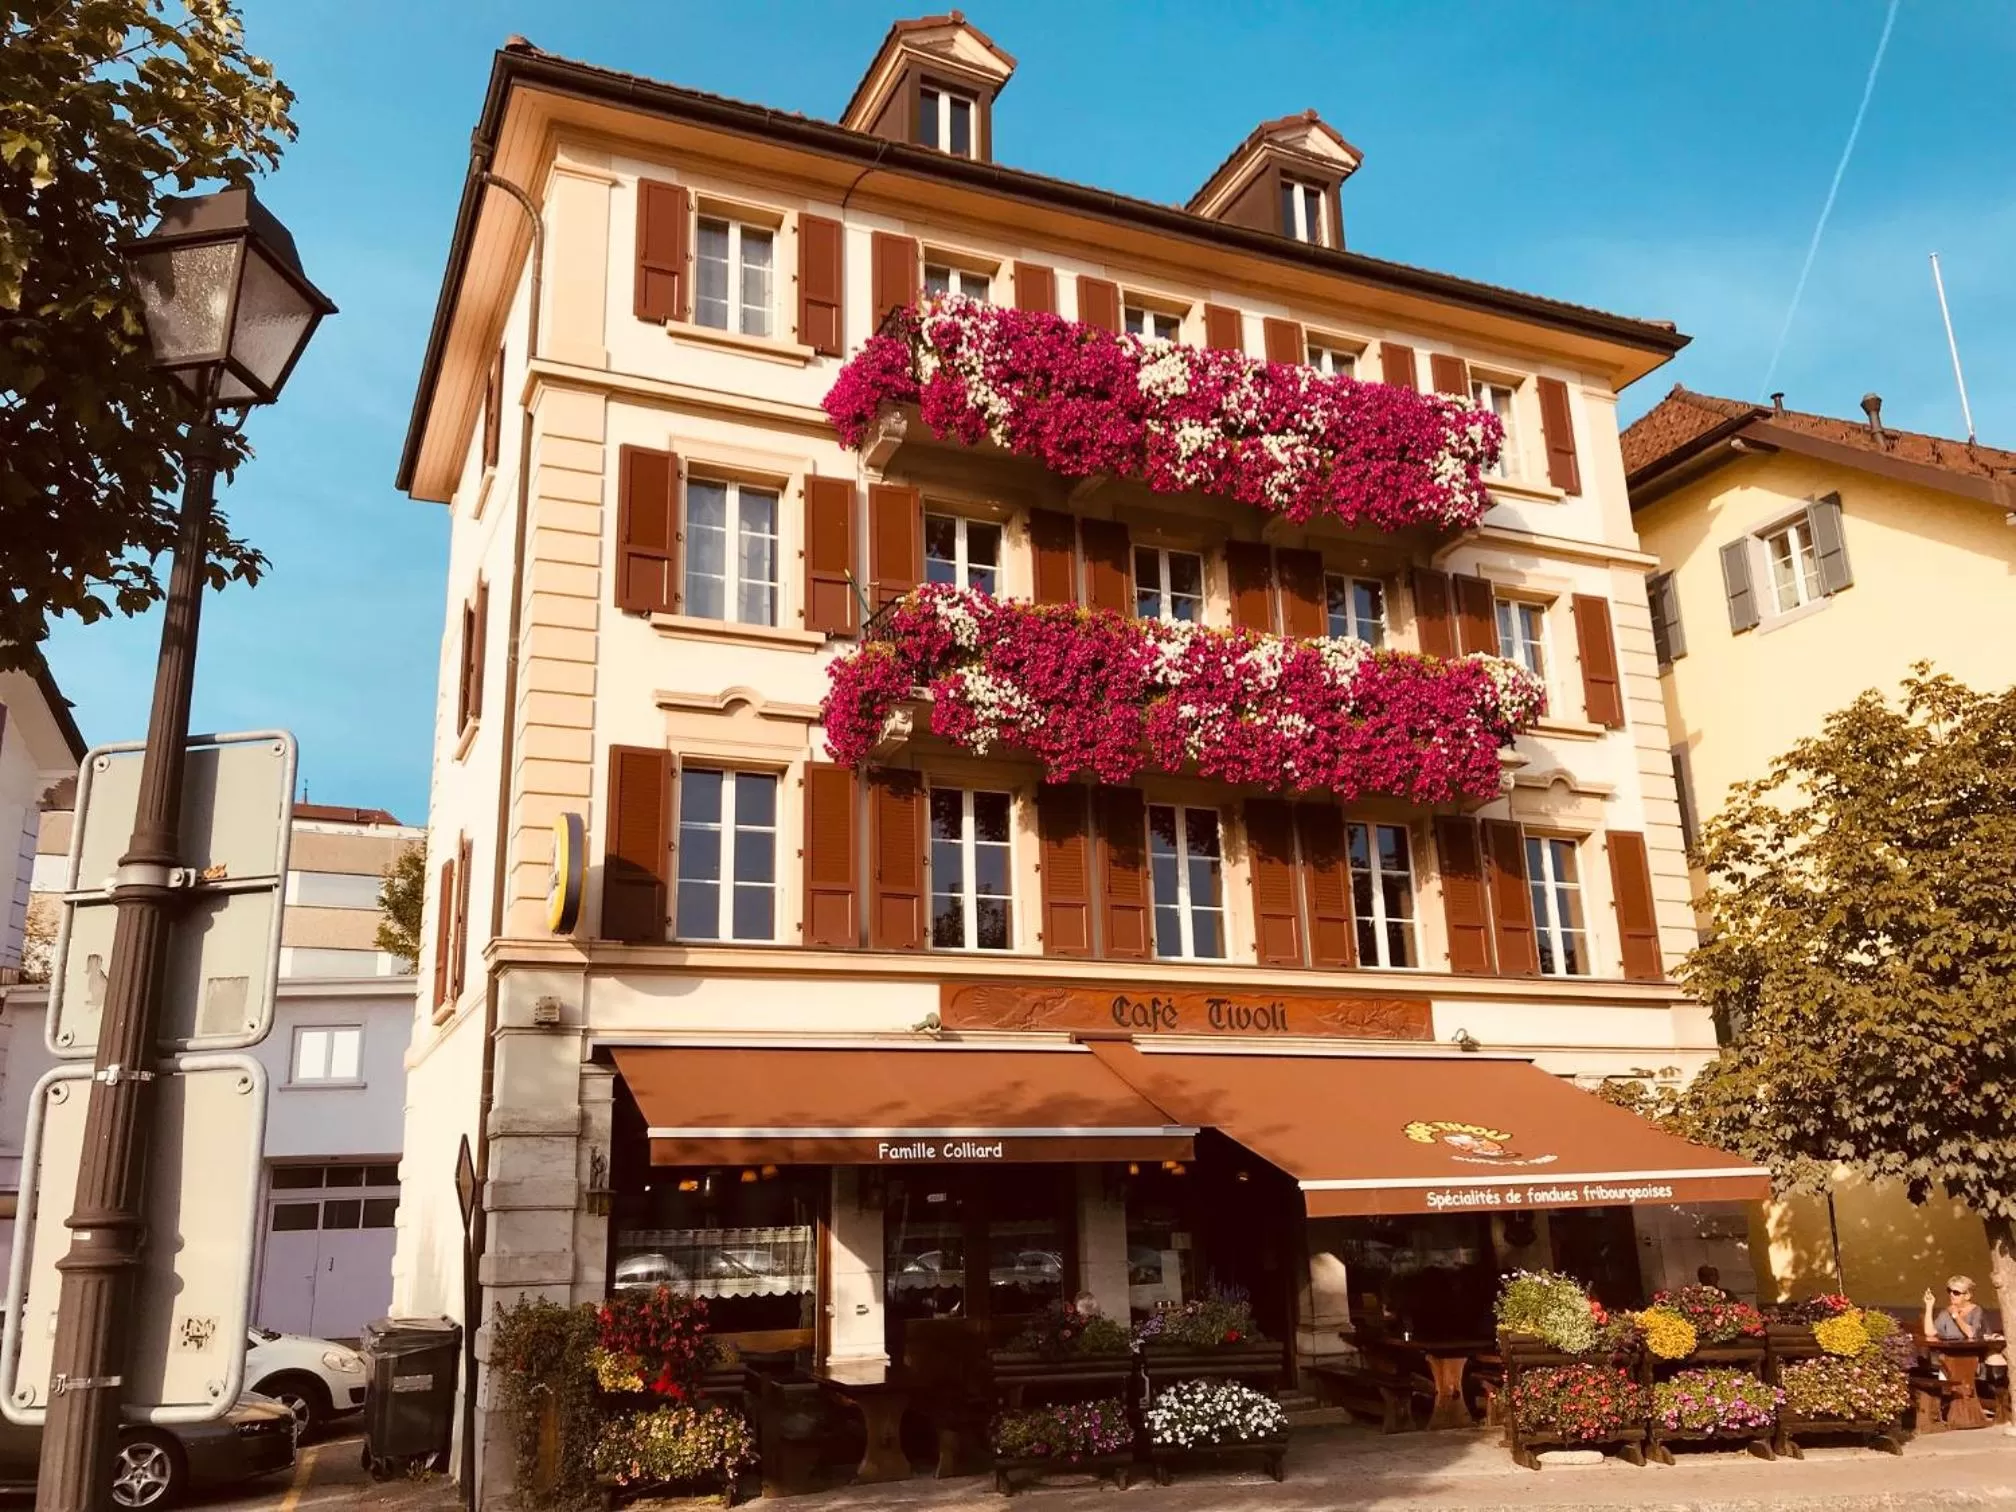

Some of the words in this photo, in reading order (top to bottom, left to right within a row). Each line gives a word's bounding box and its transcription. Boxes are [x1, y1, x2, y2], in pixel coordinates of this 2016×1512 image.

[1112, 995, 1178, 1032] Café
[1205, 998, 1288, 1031] Tivoli
[878, 1143, 937, 1159] Famille
[943, 1142, 1003, 1158] Colliard
[1426, 1189, 1501, 1210] Spécialités
[1506, 1189, 1522, 1204] de
[1526, 1186, 1579, 1204] fondues
[1583, 1184, 1673, 1204] fribourgeoises
